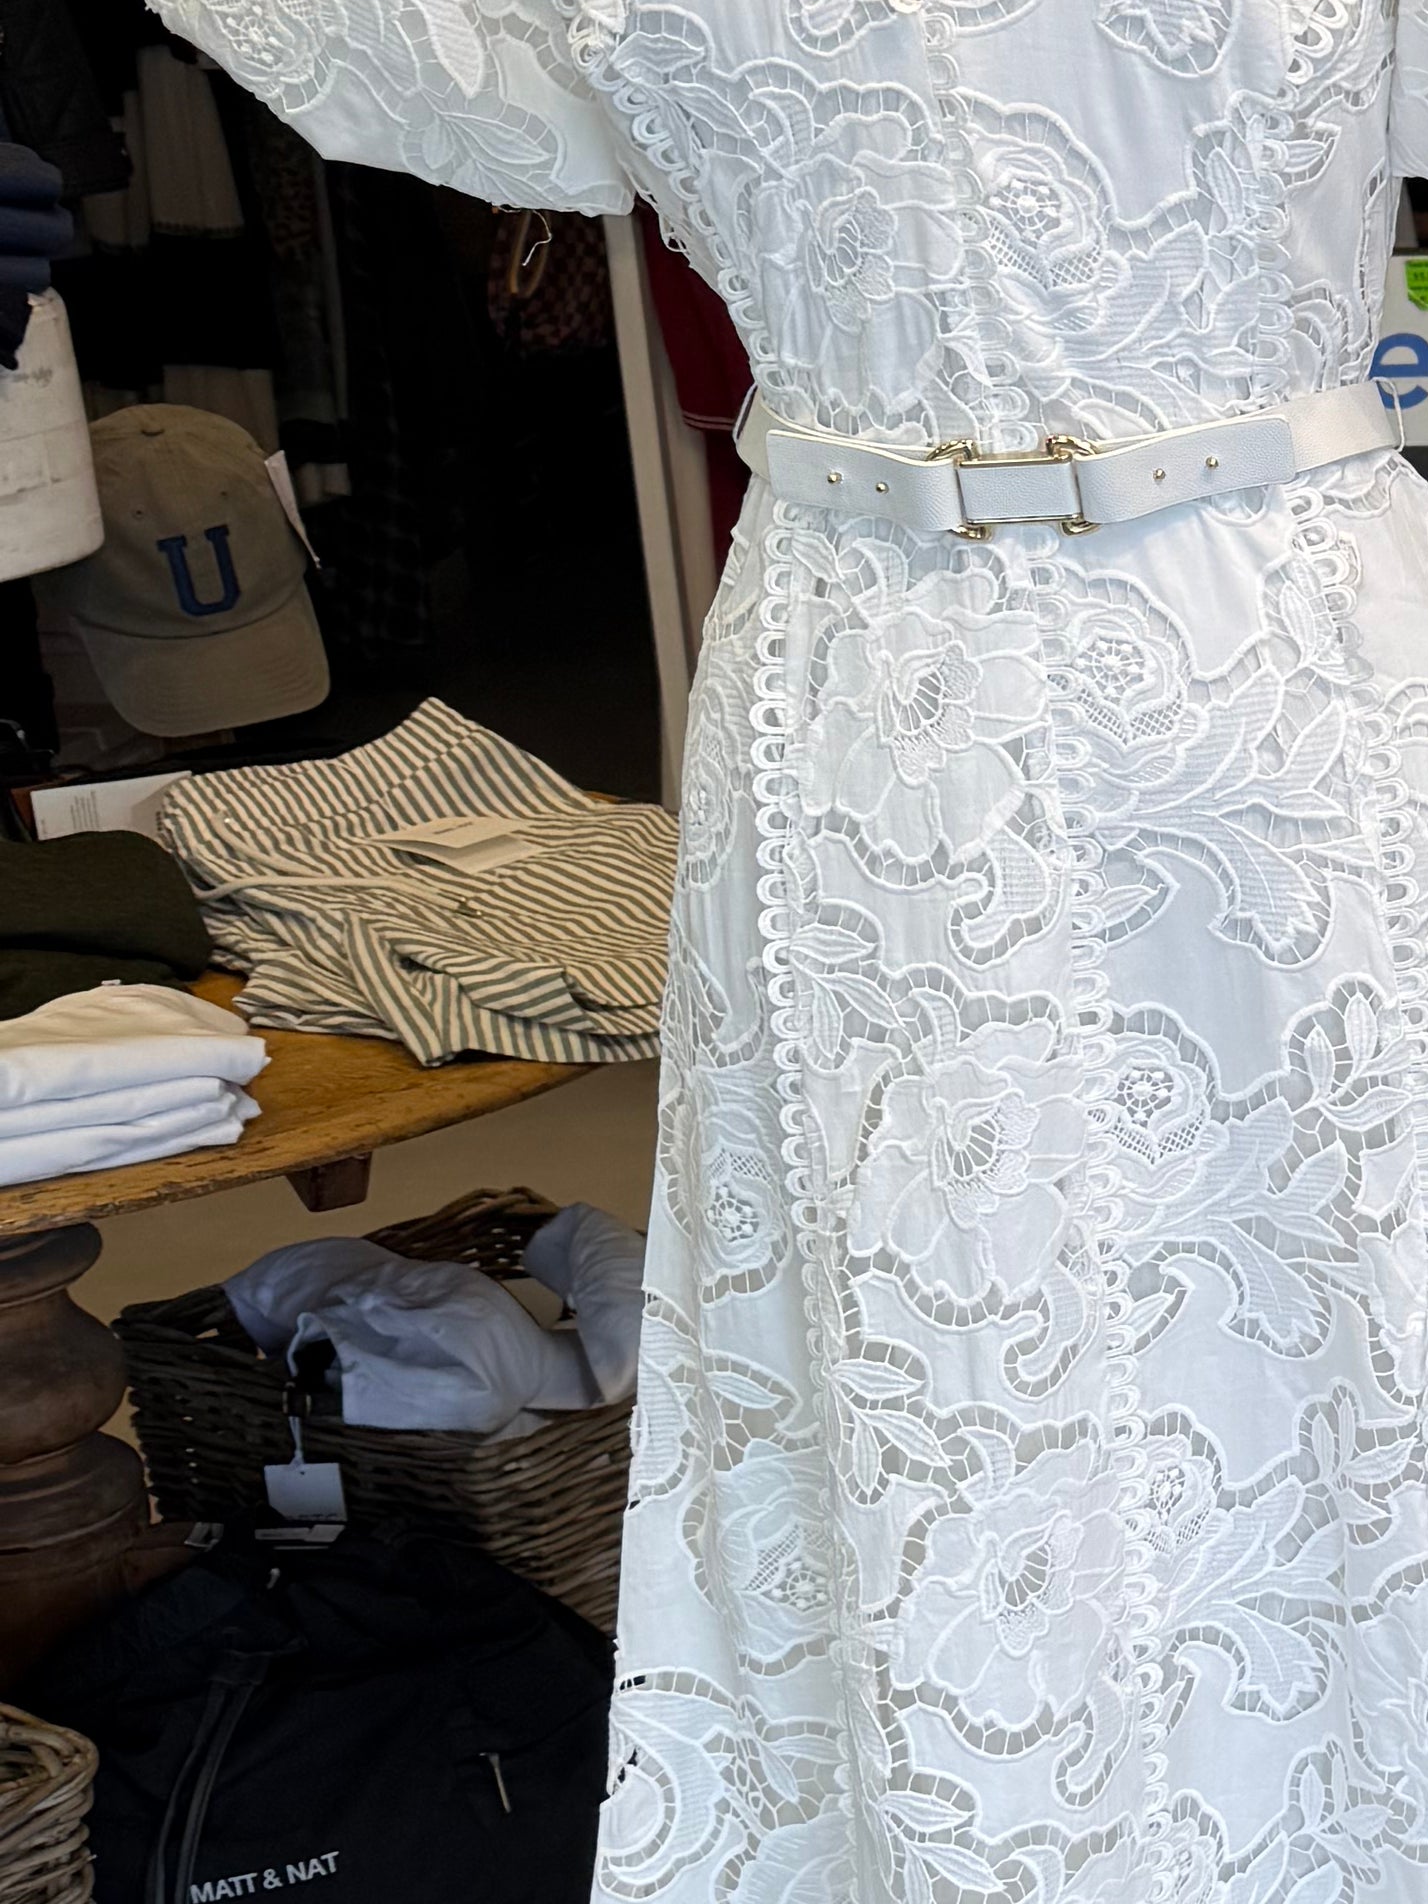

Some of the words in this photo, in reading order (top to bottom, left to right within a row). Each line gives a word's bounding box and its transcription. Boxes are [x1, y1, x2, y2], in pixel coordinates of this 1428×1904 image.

[157, 525, 241, 617] U
[190, 1872, 258, 1904] MATT
[263, 1868, 283, 1890] &
[286, 1851, 340, 1884] NAT
